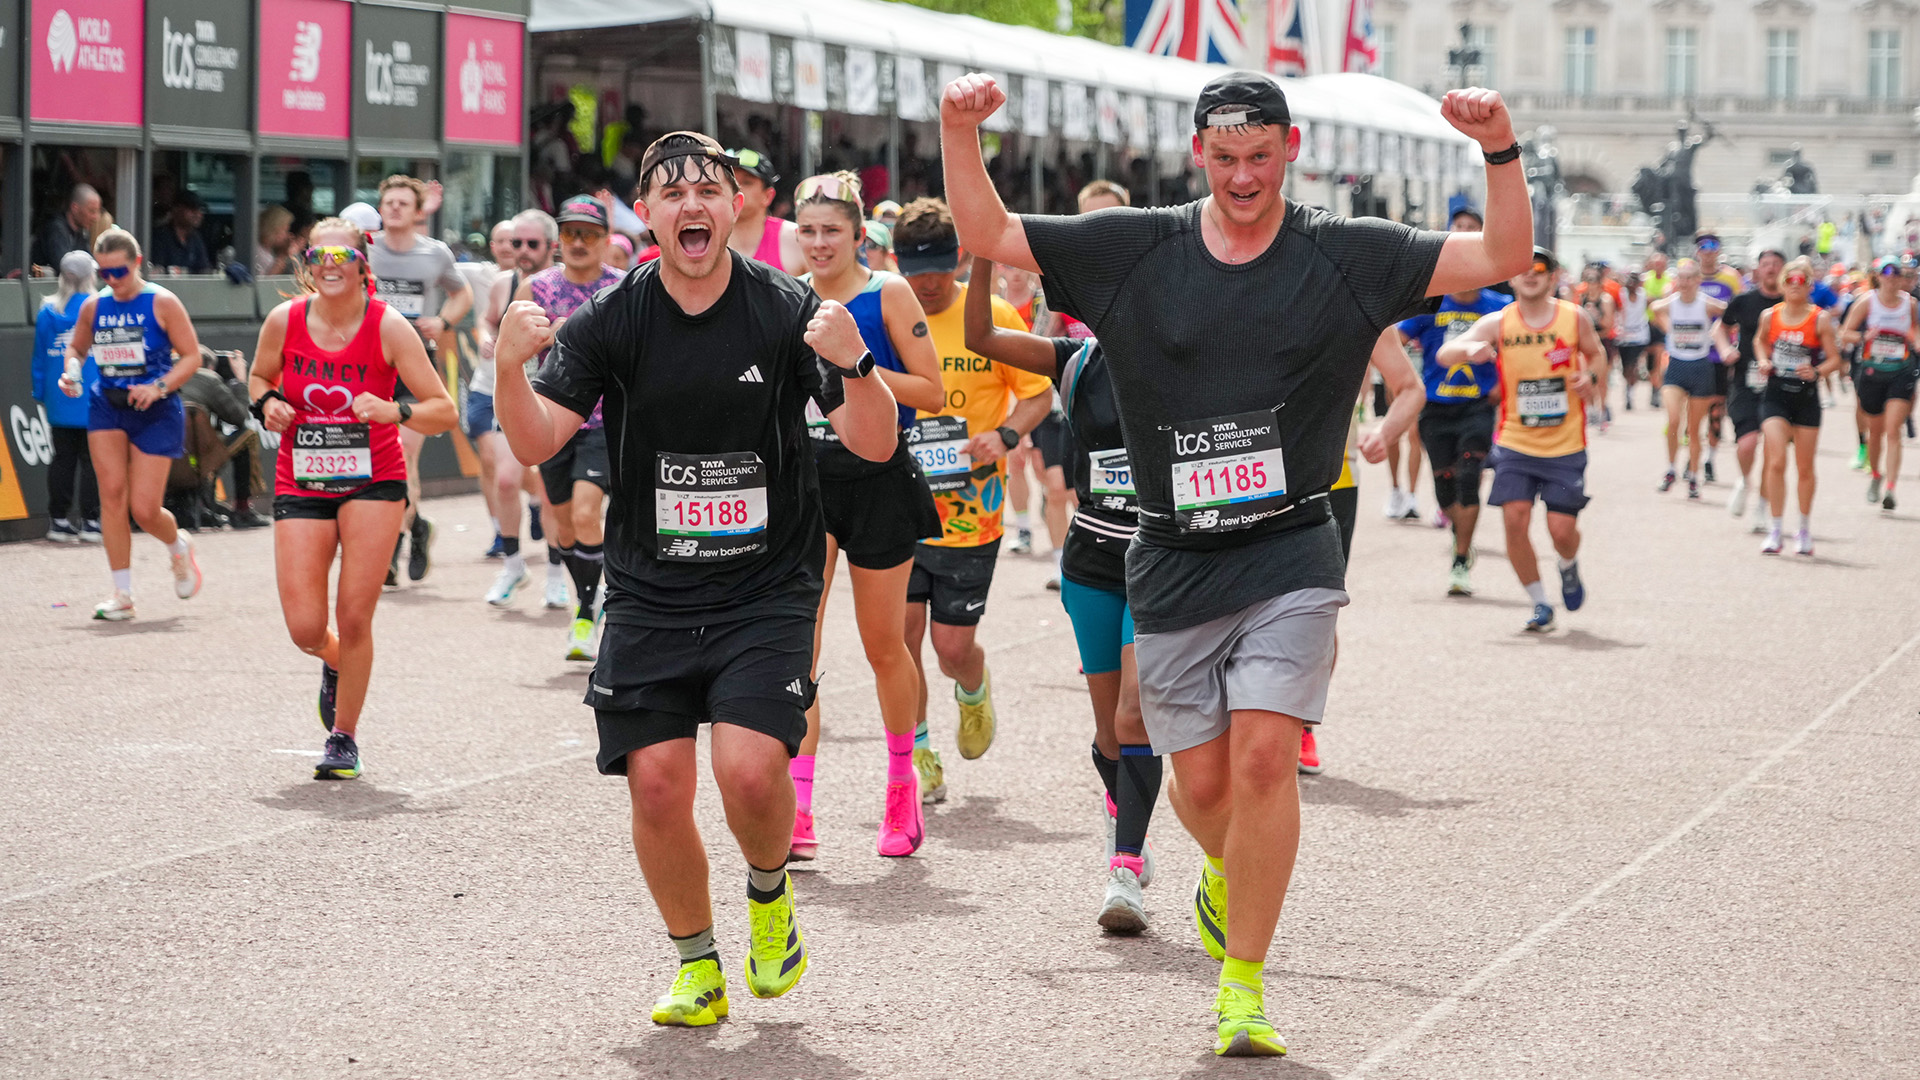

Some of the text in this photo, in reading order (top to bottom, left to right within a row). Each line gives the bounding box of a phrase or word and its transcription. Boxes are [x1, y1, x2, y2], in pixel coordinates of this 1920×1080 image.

[78, 17, 111, 44] WORLD
[78, 45, 126, 72] ATHLETICS
[163, 16, 195, 89] tcs
[195, 45, 239, 69] CONSULTANCY
[194, 69, 224, 92] SERVICES
[365, 39, 393, 105] tcs
[292, 356, 368, 382] NANCY
[939, 357, 992, 372] FRICA
[297, 427, 324, 446] tcs
[1212, 422, 1238, 432] TATA
[1213, 426, 1271, 442] CONSULTANCY
[1174, 431, 1211, 456] tcs
[1215, 438, 1252, 451] SERVICES
[305, 456, 358, 474] 23323
[661, 459, 697, 485] tcs
[701, 460, 725, 469] TATA
[701, 466, 758, 477] CONSULTANCY
[701, 476, 738, 485] SERVICES
[1105, 470, 1134, 485] 56
[1189, 461, 1268, 498] 11185
[674, 499, 748, 526] 15188
[1221, 517, 1240, 526] new
[699, 549, 719, 557] new
